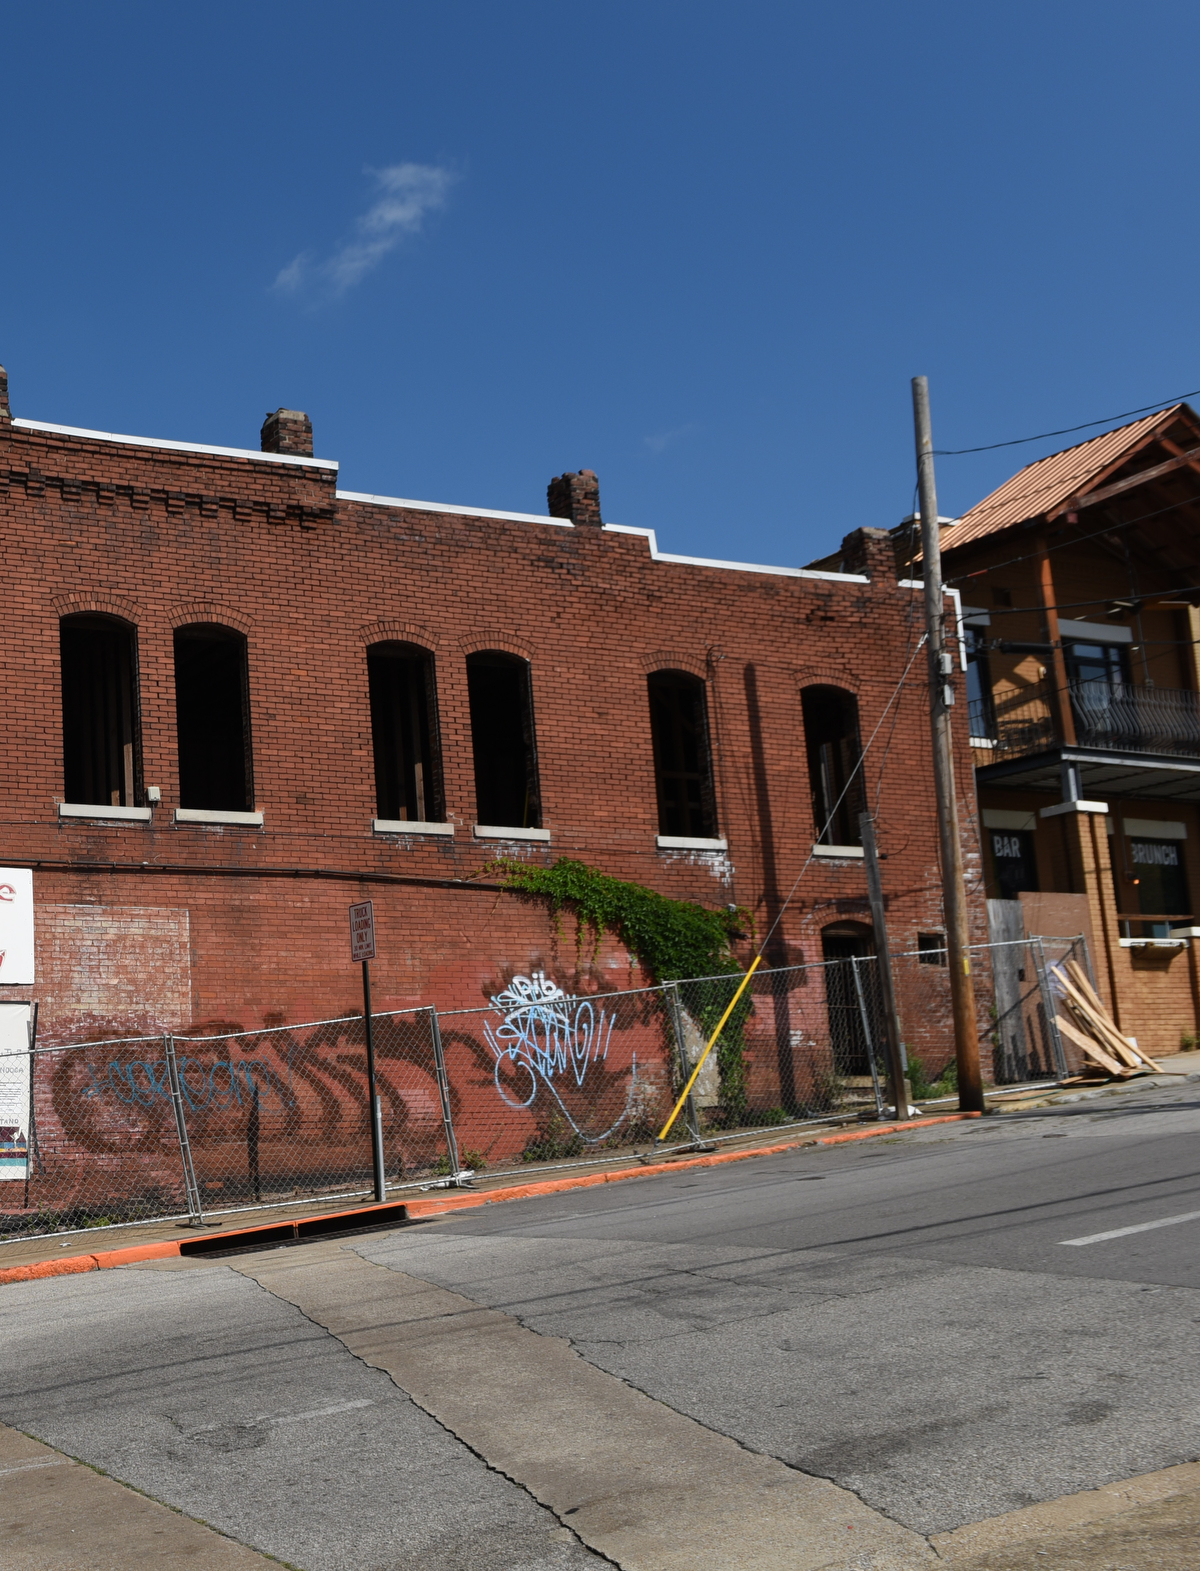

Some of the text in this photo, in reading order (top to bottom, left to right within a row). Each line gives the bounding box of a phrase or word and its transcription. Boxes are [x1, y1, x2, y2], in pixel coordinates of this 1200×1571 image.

[993, 836, 1021, 858] BAR
[1130, 843, 1179, 866] BRUNCH
[353, 906, 368, 919] TRUCK
[352, 918, 371, 932] LOADING
[357, 931, 368, 943] ONLY
